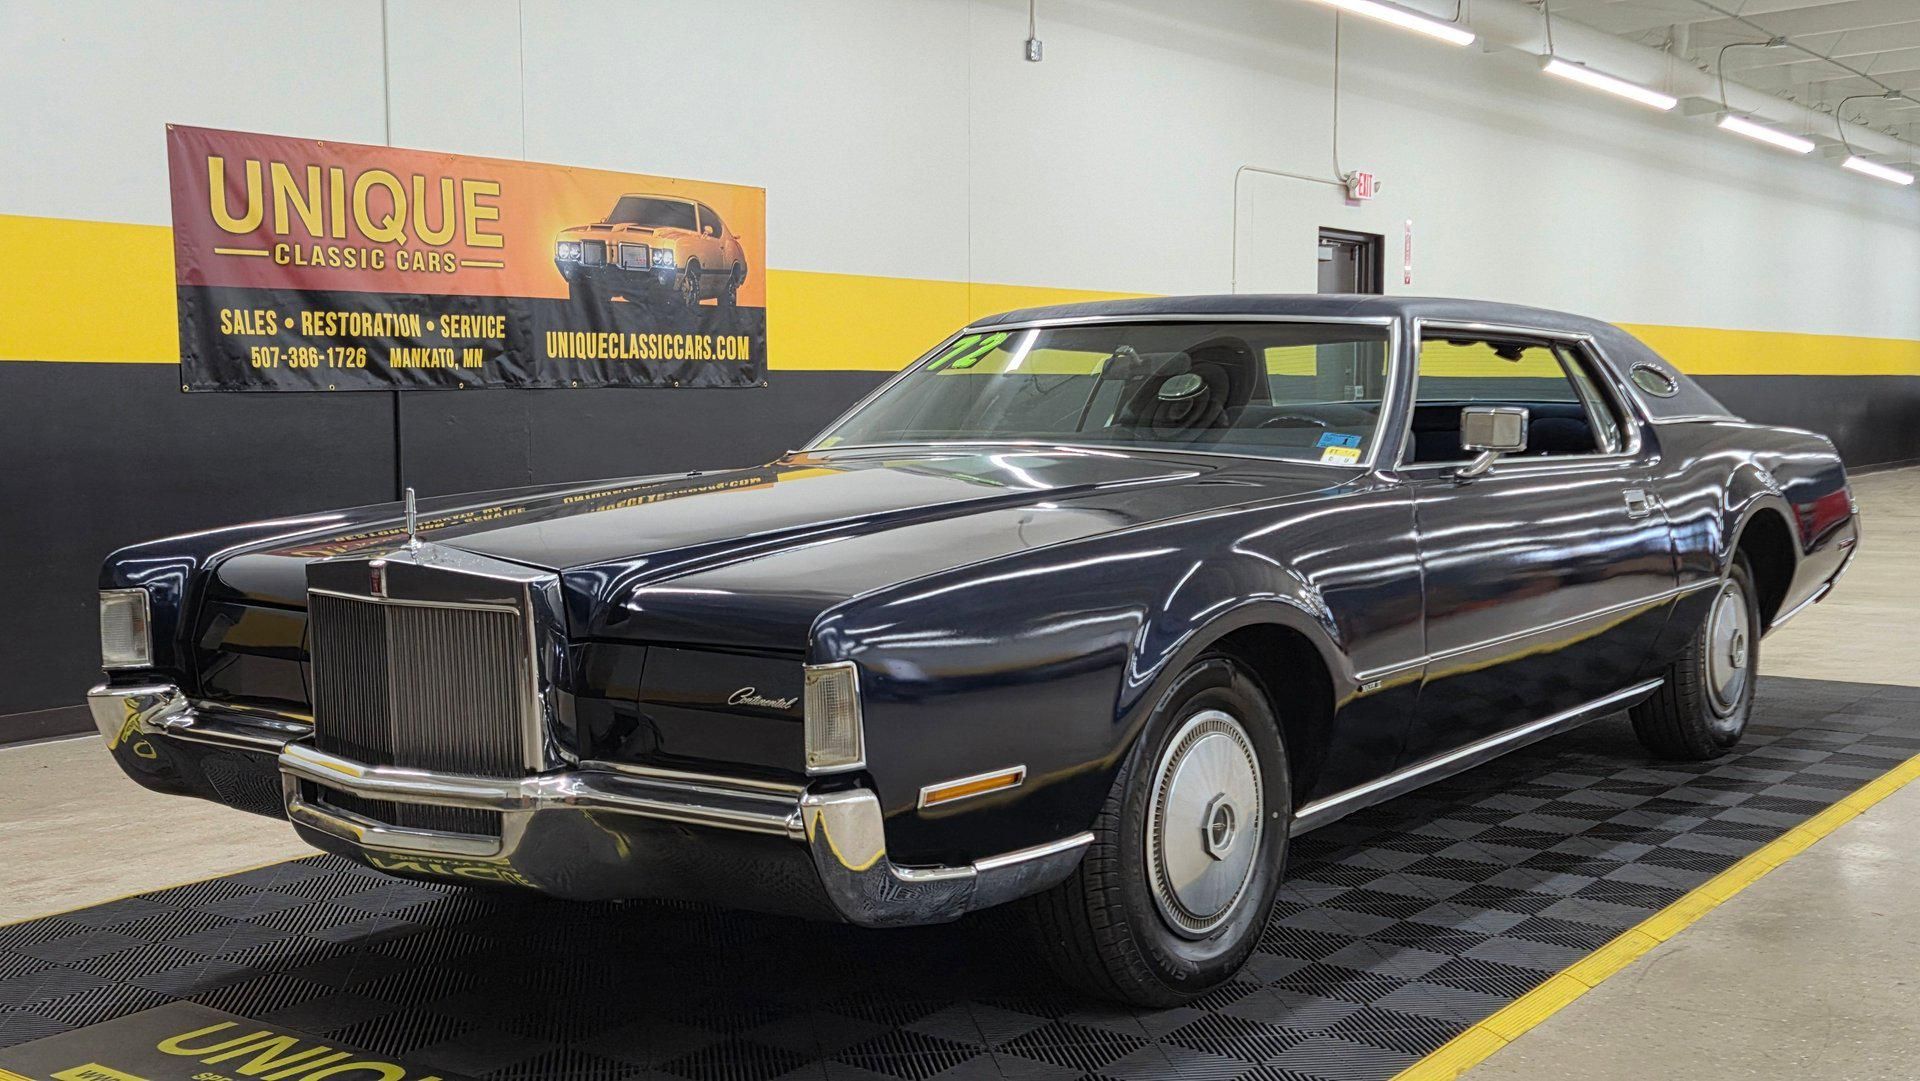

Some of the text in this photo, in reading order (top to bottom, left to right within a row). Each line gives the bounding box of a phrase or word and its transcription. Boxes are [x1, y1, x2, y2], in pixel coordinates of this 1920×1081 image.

[1358, 172, 1373, 197] EXIT
[208, 156, 504, 248] UNIQUE
[275, 243, 457, 273] CLASSIC CARS
[220, 309, 506, 339] SALES RESTORATION SERVICE
[251, 346, 367, 368] 507-386-1726
[390, 348, 483, 370] MANKATO, MN
[546, 331, 750, 360] UNIQUECLASSICCARS.COM
[927, 332, 1009, 371] 72
[728, 687, 799, 710] Continental
[157, 1021, 444, 1081] UNI
